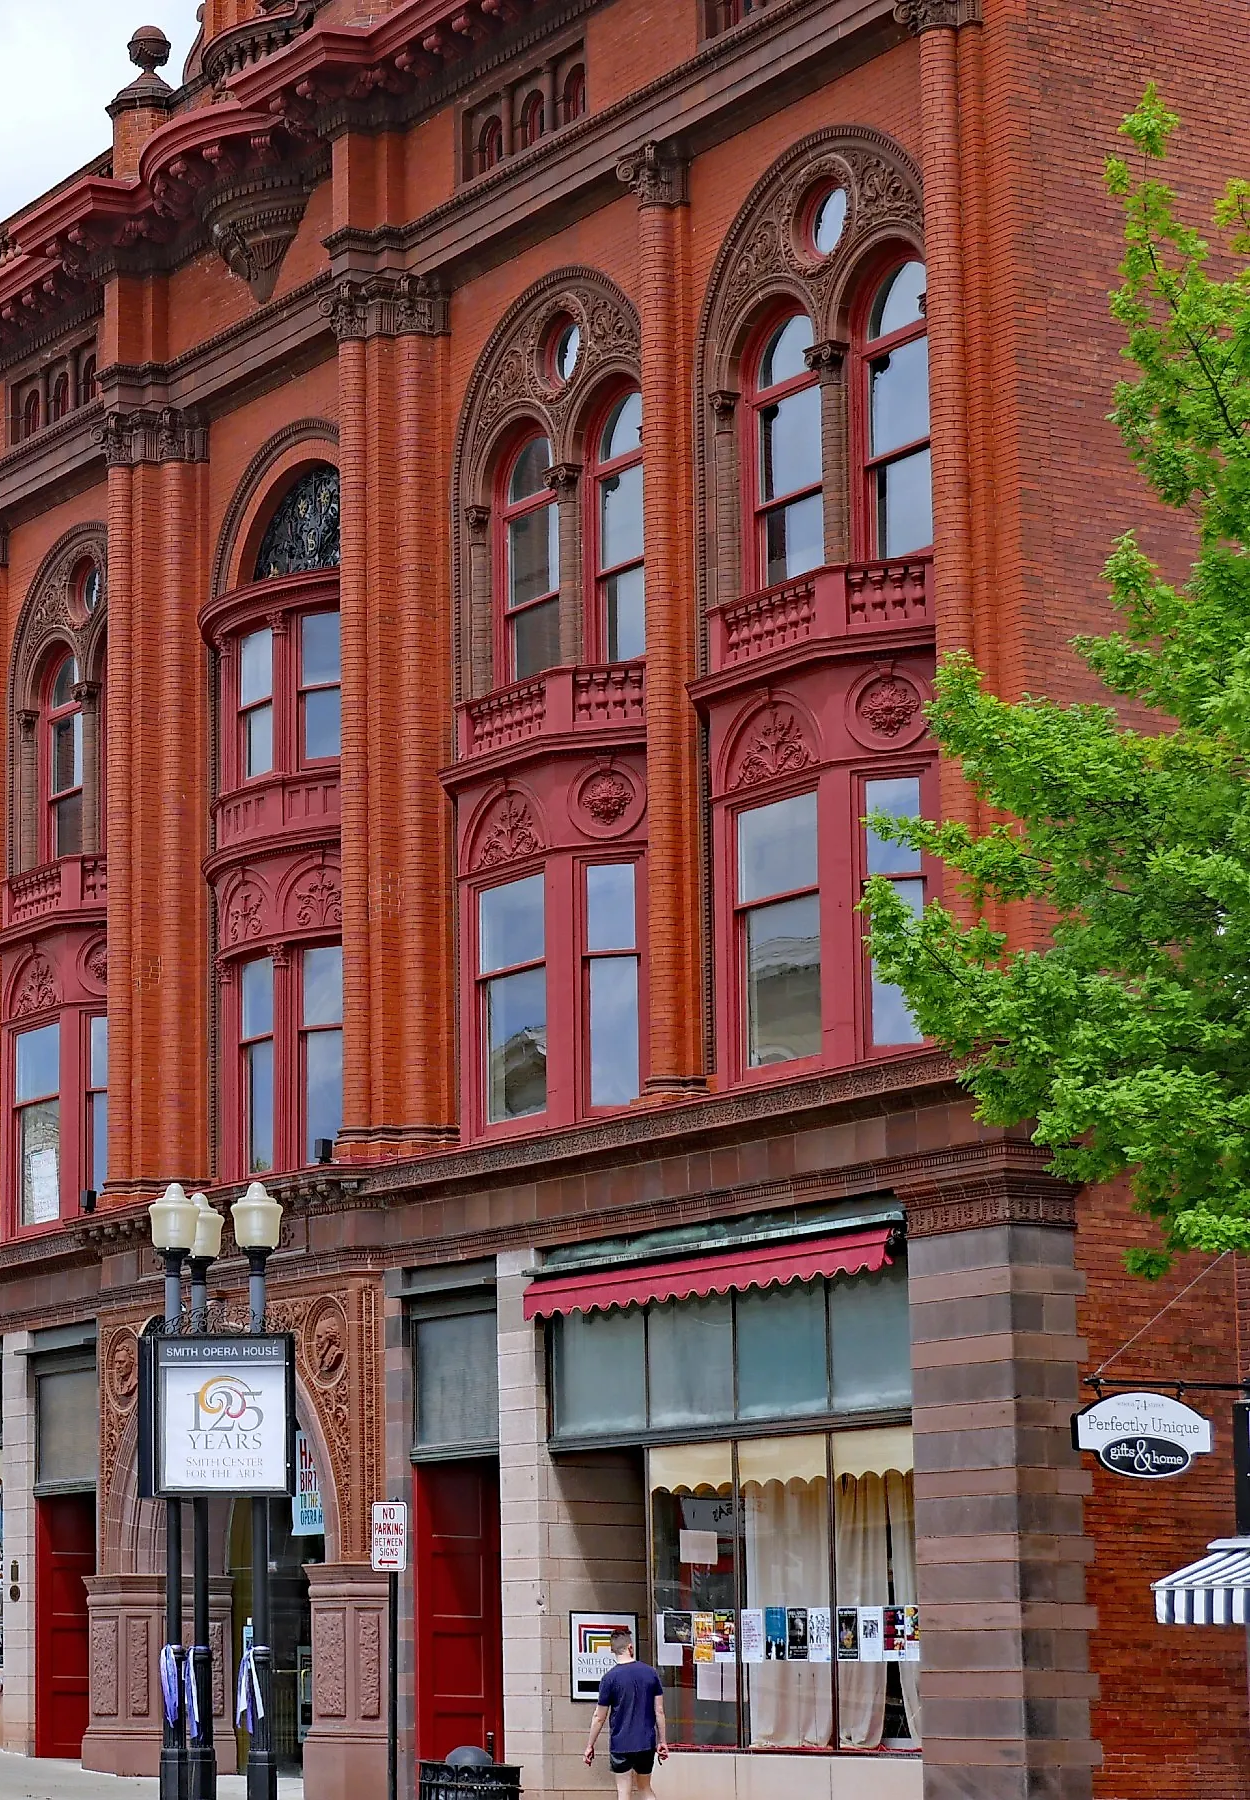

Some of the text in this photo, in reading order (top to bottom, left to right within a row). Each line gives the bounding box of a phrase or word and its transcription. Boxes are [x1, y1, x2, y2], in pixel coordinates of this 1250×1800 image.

[166, 1346, 279, 1357] SMITH OPERA HOUSE
[186, 1380, 264, 1432] 125
[1087, 1414, 1200, 1436] Perfectly Unique
[187, 1433, 262, 1450] YEARS
[186, 1456, 263, 1467] SMITH CENTER
[1110, 1439, 1183, 1472] gifts & home
[186, 1469, 263, 1478] FOR THE ARTS
[299, 1493, 307, 1509] TO
[300, 1509, 317, 1526] OPERA
[382, 1507, 395, 1520] NO
[375, 1522, 404, 1536] PARKING
[375, 1537, 403, 1547] BETWEEN
[379, 1547, 399, 1557] SIGNS
[577, 1656, 600, 1666] SMITH
